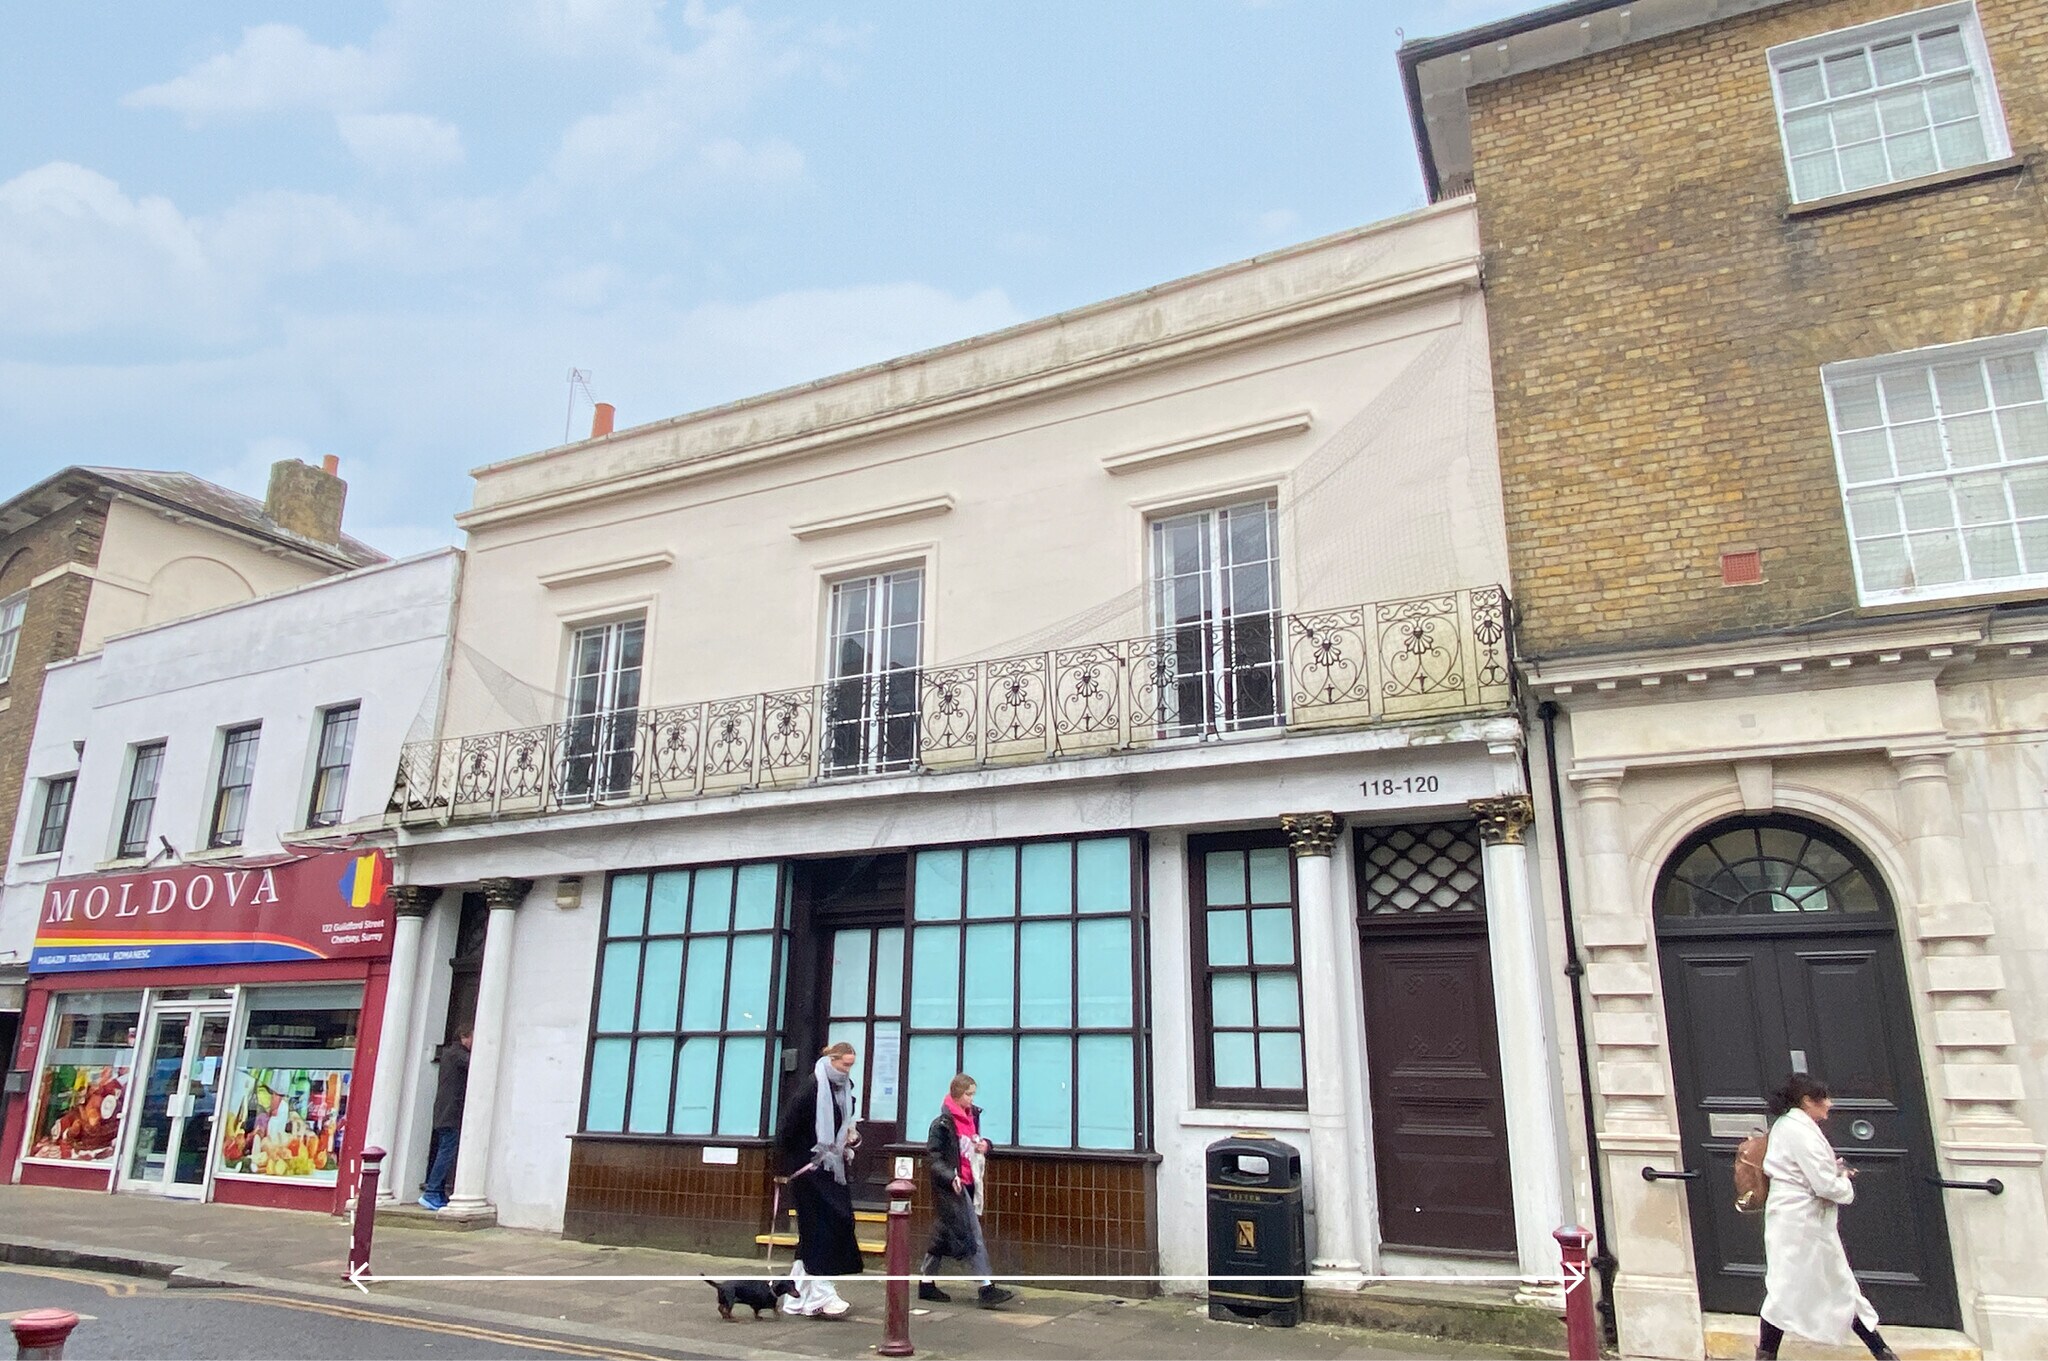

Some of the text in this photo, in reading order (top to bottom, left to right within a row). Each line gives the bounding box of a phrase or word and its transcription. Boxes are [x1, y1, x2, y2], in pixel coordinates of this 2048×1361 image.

[1360, 775, 1439, 797] 118-120
[45, 868, 280, 923] MOLDOVA
[364, 919, 385, 929] Street
[361, 933, 383, 942] Surrey
[38, 955, 67, 965] MAGAZIN
